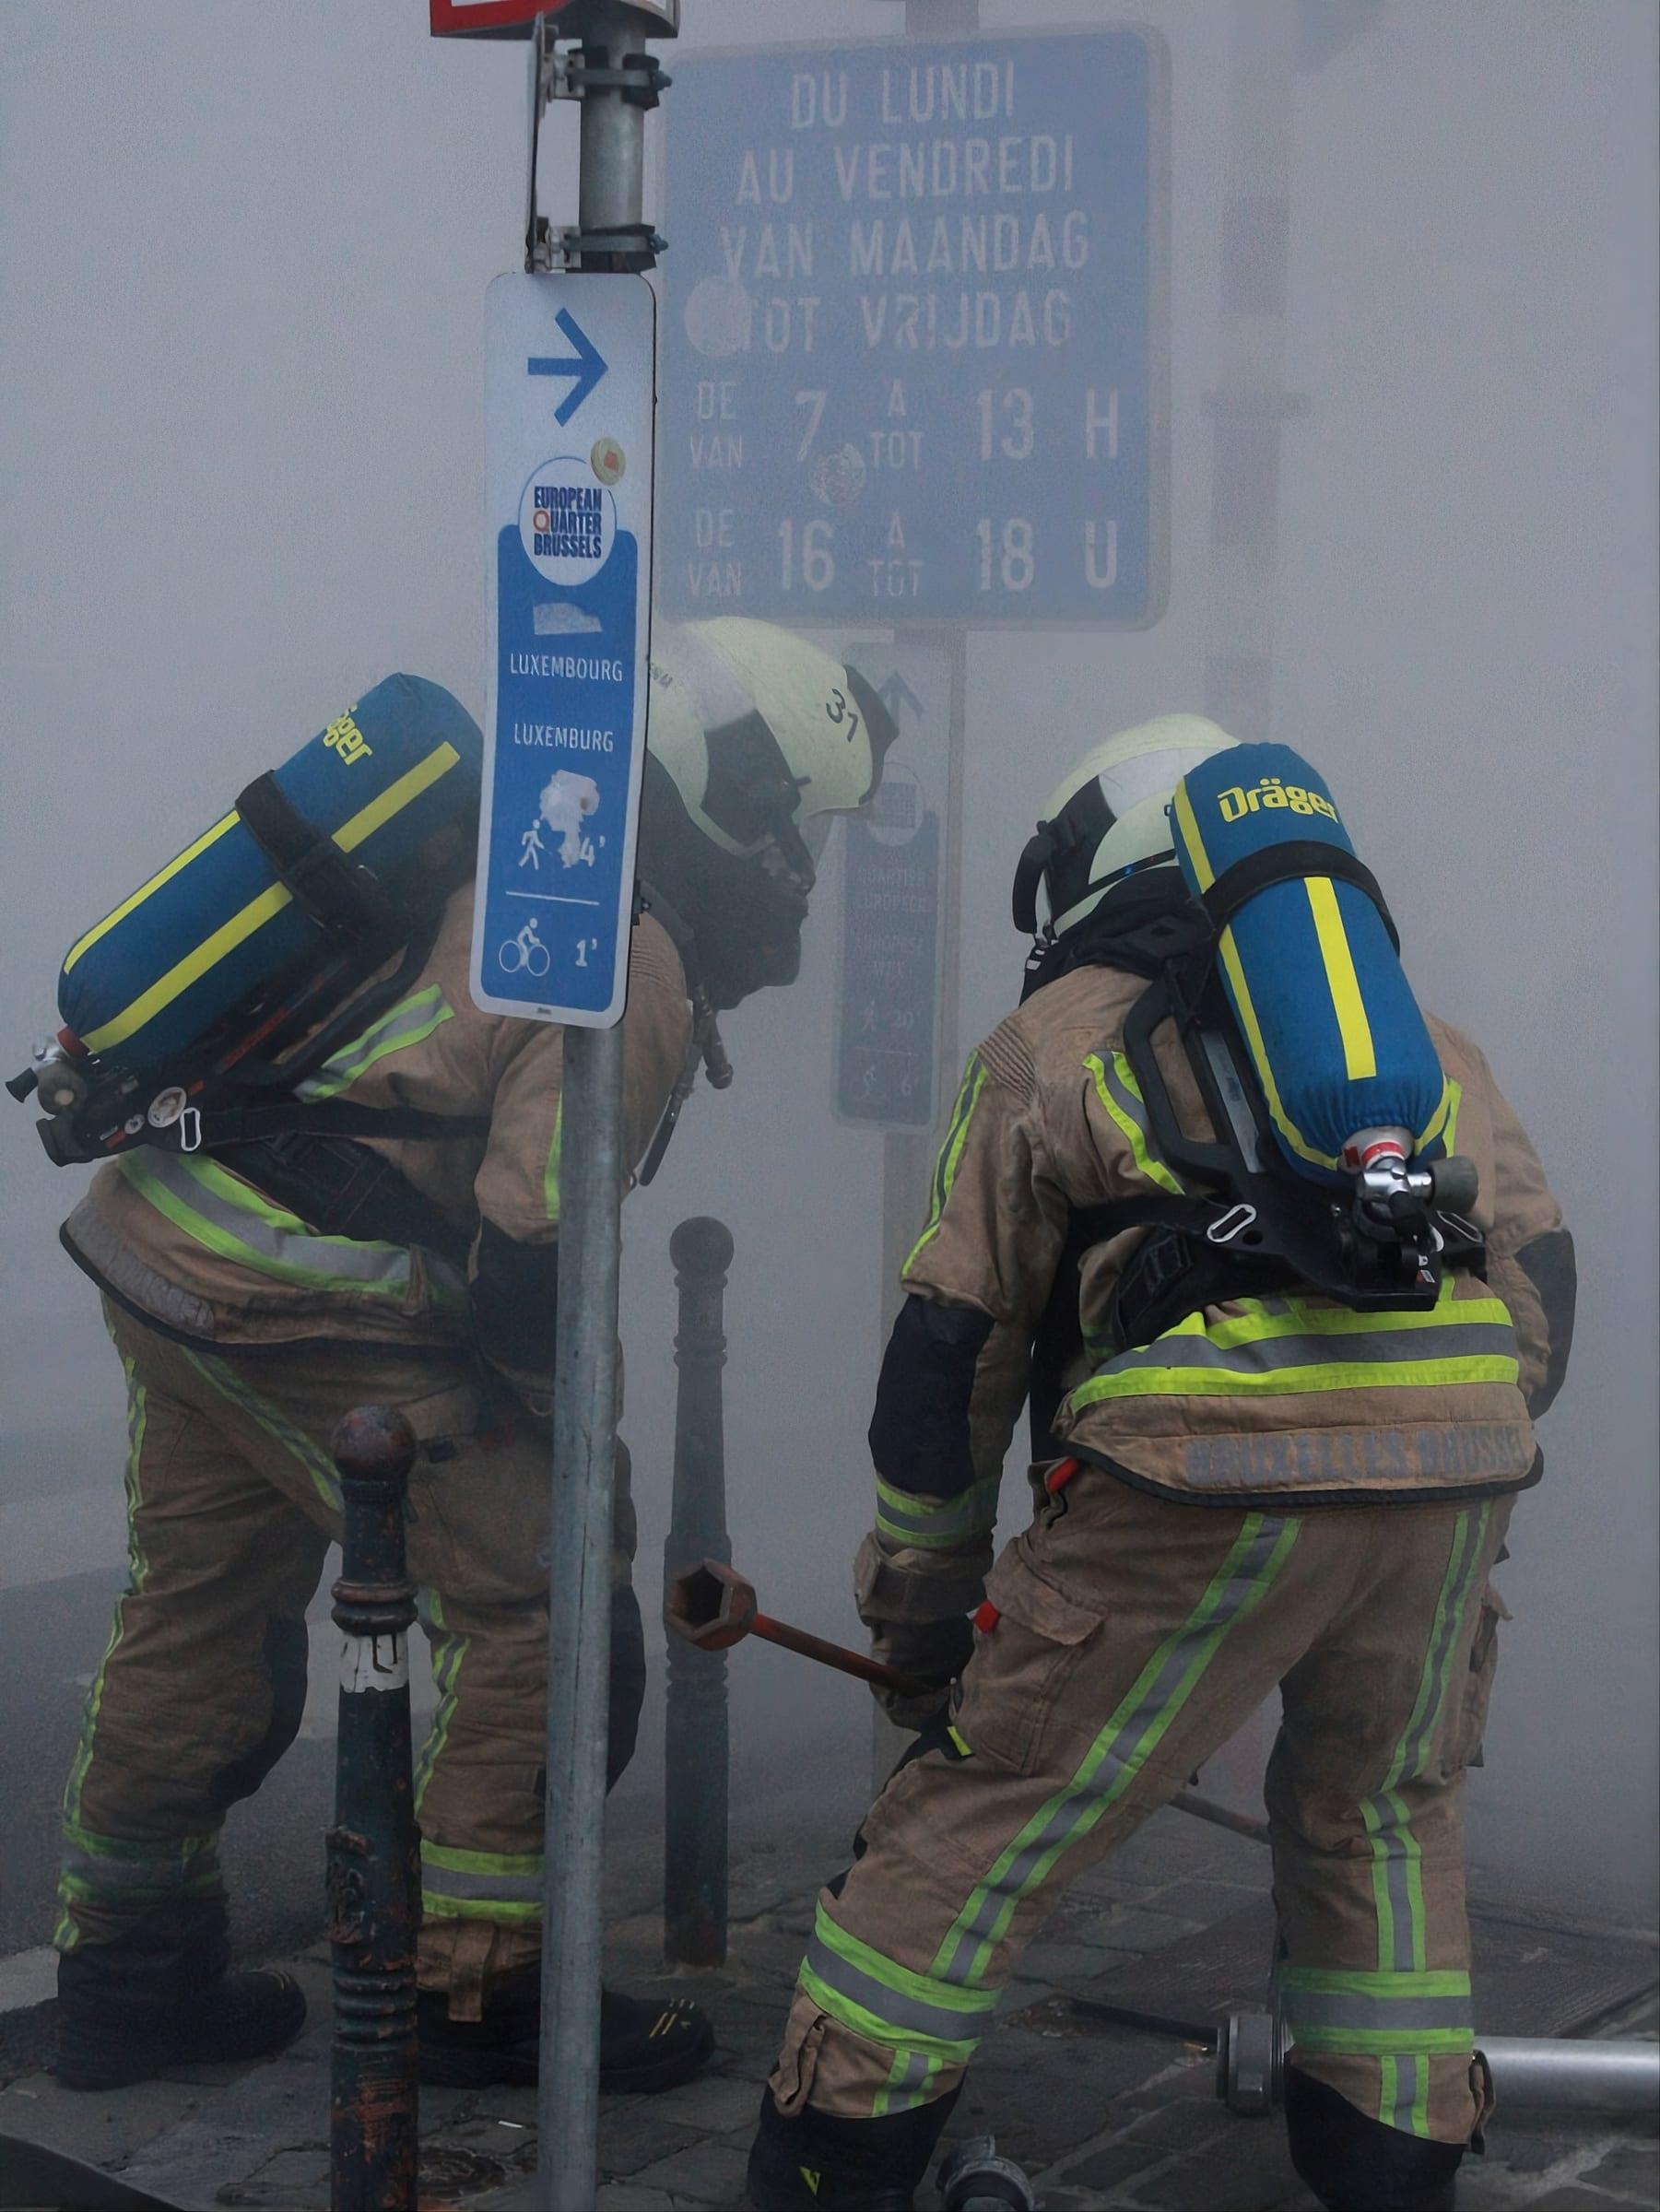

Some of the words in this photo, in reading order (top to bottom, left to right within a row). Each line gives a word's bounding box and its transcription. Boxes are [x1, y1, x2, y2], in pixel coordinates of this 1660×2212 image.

[791, 71, 848, 130] DU
[881, 59, 1014, 124] LUNDI
[737, 148, 794, 206] AU
[834, 134, 1074, 201] VENDREDI
[720, 221, 814, 278] VAN
[850, 210, 1089, 276] MAANDAG
[860, 288, 1072, 349] VRIJDAG
[697, 381, 737, 421] DE
[888, 378, 907, 418] A
[795, 390, 827, 462] 7
[975, 388, 1034, 460] 13
[1086, 389, 1120, 459] H
[689, 434, 743, 468] VAN
[869, 430, 924, 469] TOT
[534, 486, 602, 512] EUROPEAN
[533, 510, 602, 535] QUARTER
[696, 509, 736, 547] DE
[887, 511, 907, 549] A
[534, 534, 602, 559] BRUSSELS
[778, 518, 834, 591] 16
[975, 517, 1034, 591] 18
[1085, 520, 1117, 589] U
[689, 560, 742, 597] VAN
[867, 559, 924, 597] TOT
[511, 653, 623, 683] LUXEMBOURG
[826, 688, 858, 743] 37
[514, 723, 614, 753] LUXEMBURG
[1217, 778, 1339, 824] Dräger
